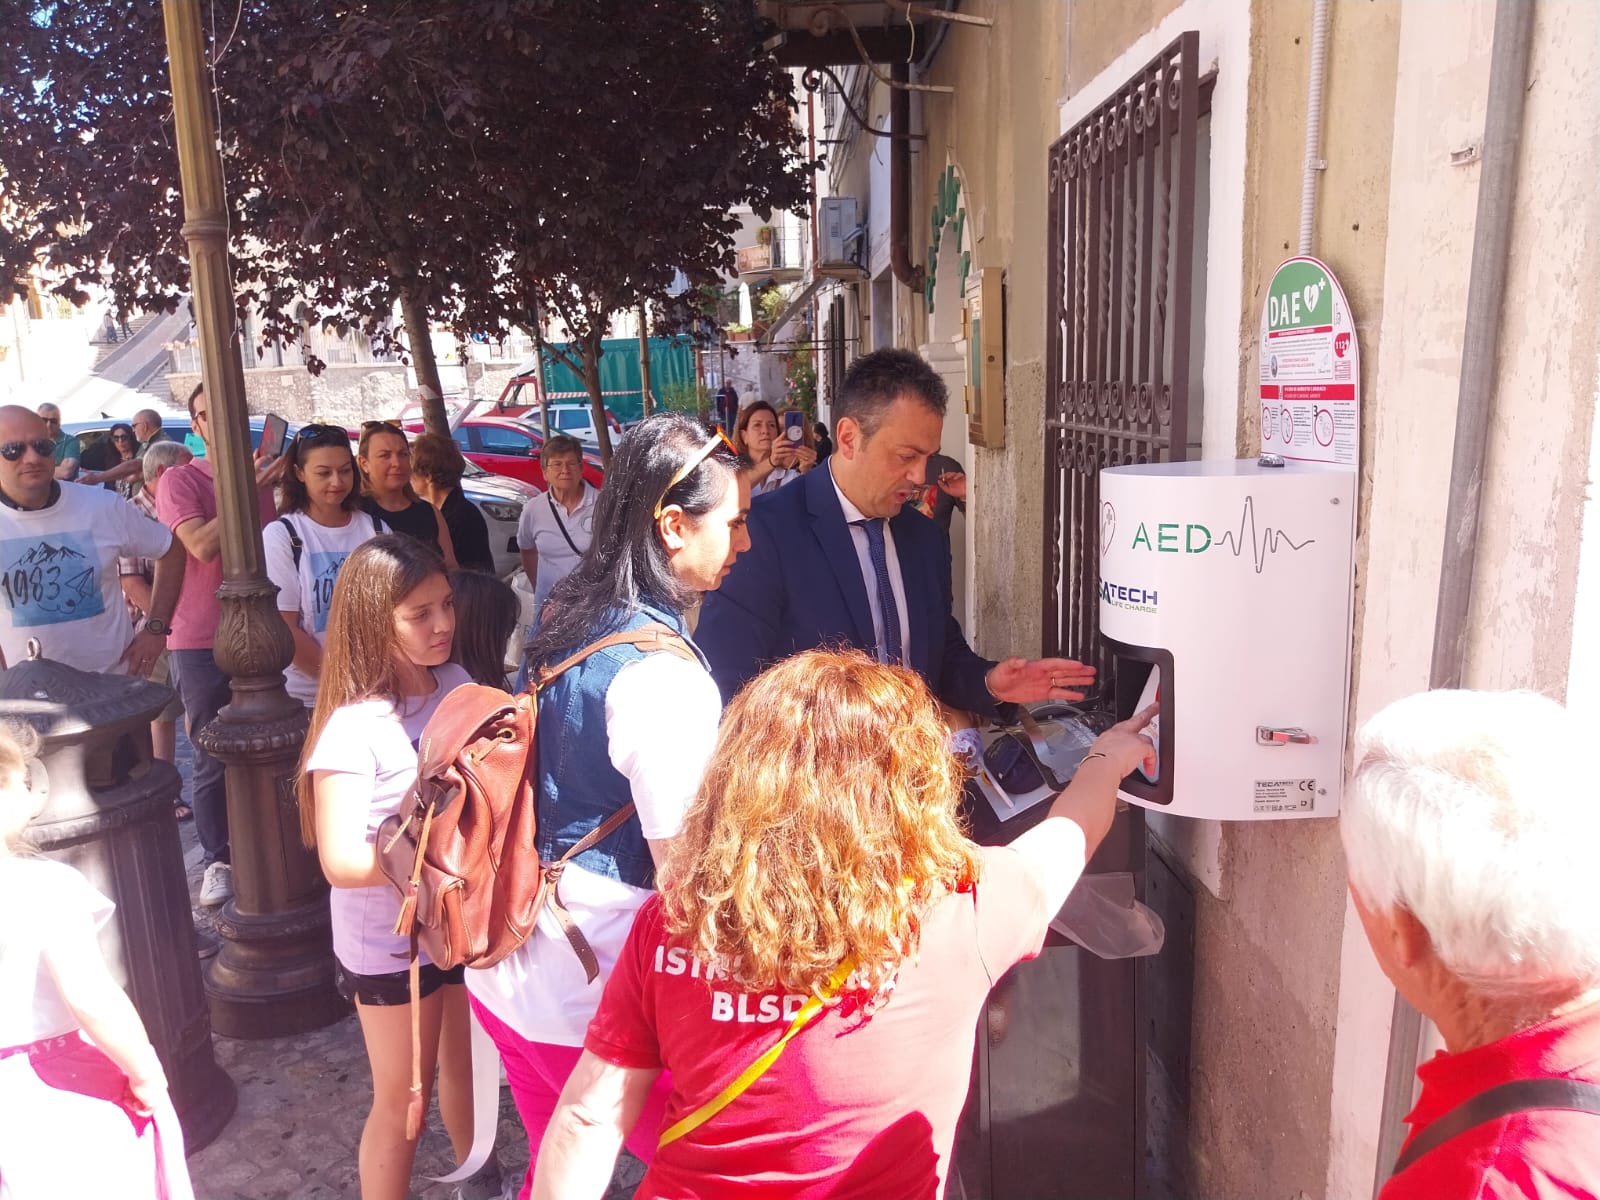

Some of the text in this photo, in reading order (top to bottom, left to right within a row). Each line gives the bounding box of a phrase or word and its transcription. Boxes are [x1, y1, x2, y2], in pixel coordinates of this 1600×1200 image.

[1270, 291, 1301, 327] DAE
[1335, 341, 1345, 350] 112
[1132, 521, 1212, 554] AED
[1, 565, 62, 609] 1983
[313, 578, 334, 615] 19
[1112, 600, 1124, 609] LIFE
[711, 991, 809, 1023] BLSD
